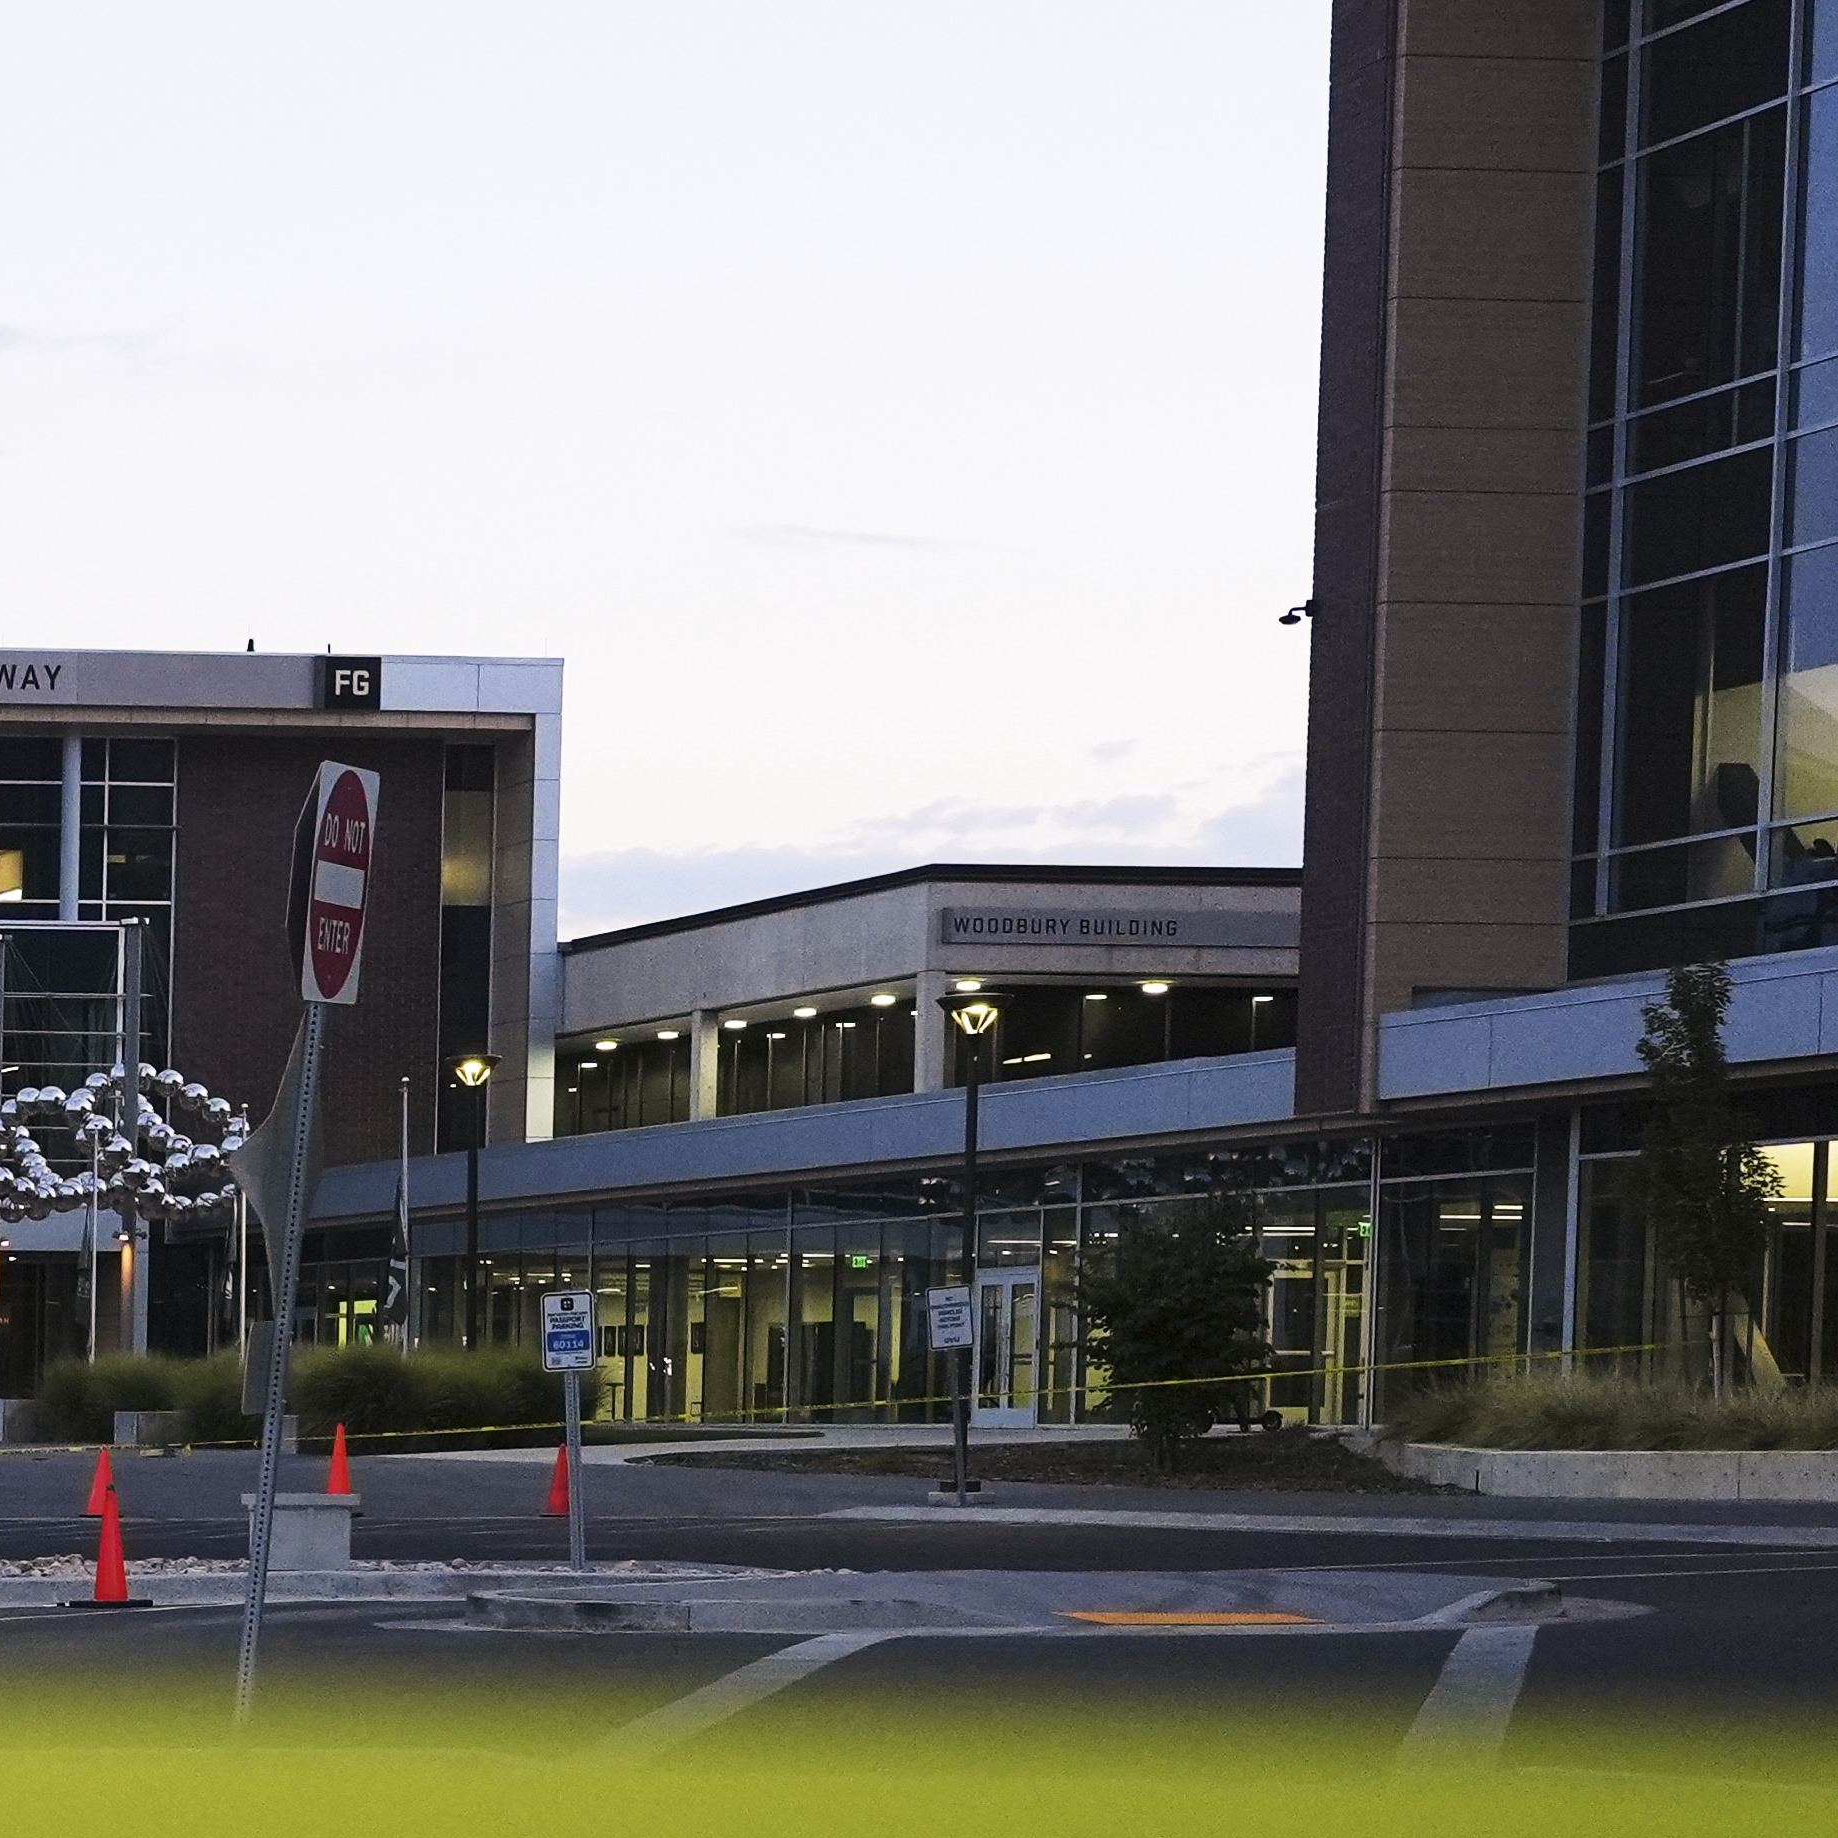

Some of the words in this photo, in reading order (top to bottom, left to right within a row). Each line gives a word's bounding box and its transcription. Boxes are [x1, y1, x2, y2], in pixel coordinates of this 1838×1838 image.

[334, 669, 370, 696] FG
[324, 812, 340, 849] DO
[343, 817, 367, 855] NOT
[317, 916, 352, 954] ENTER
[953, 917, 1071, 935] WOODBURY
[1078, 918, 1178, 937] BUILDING
